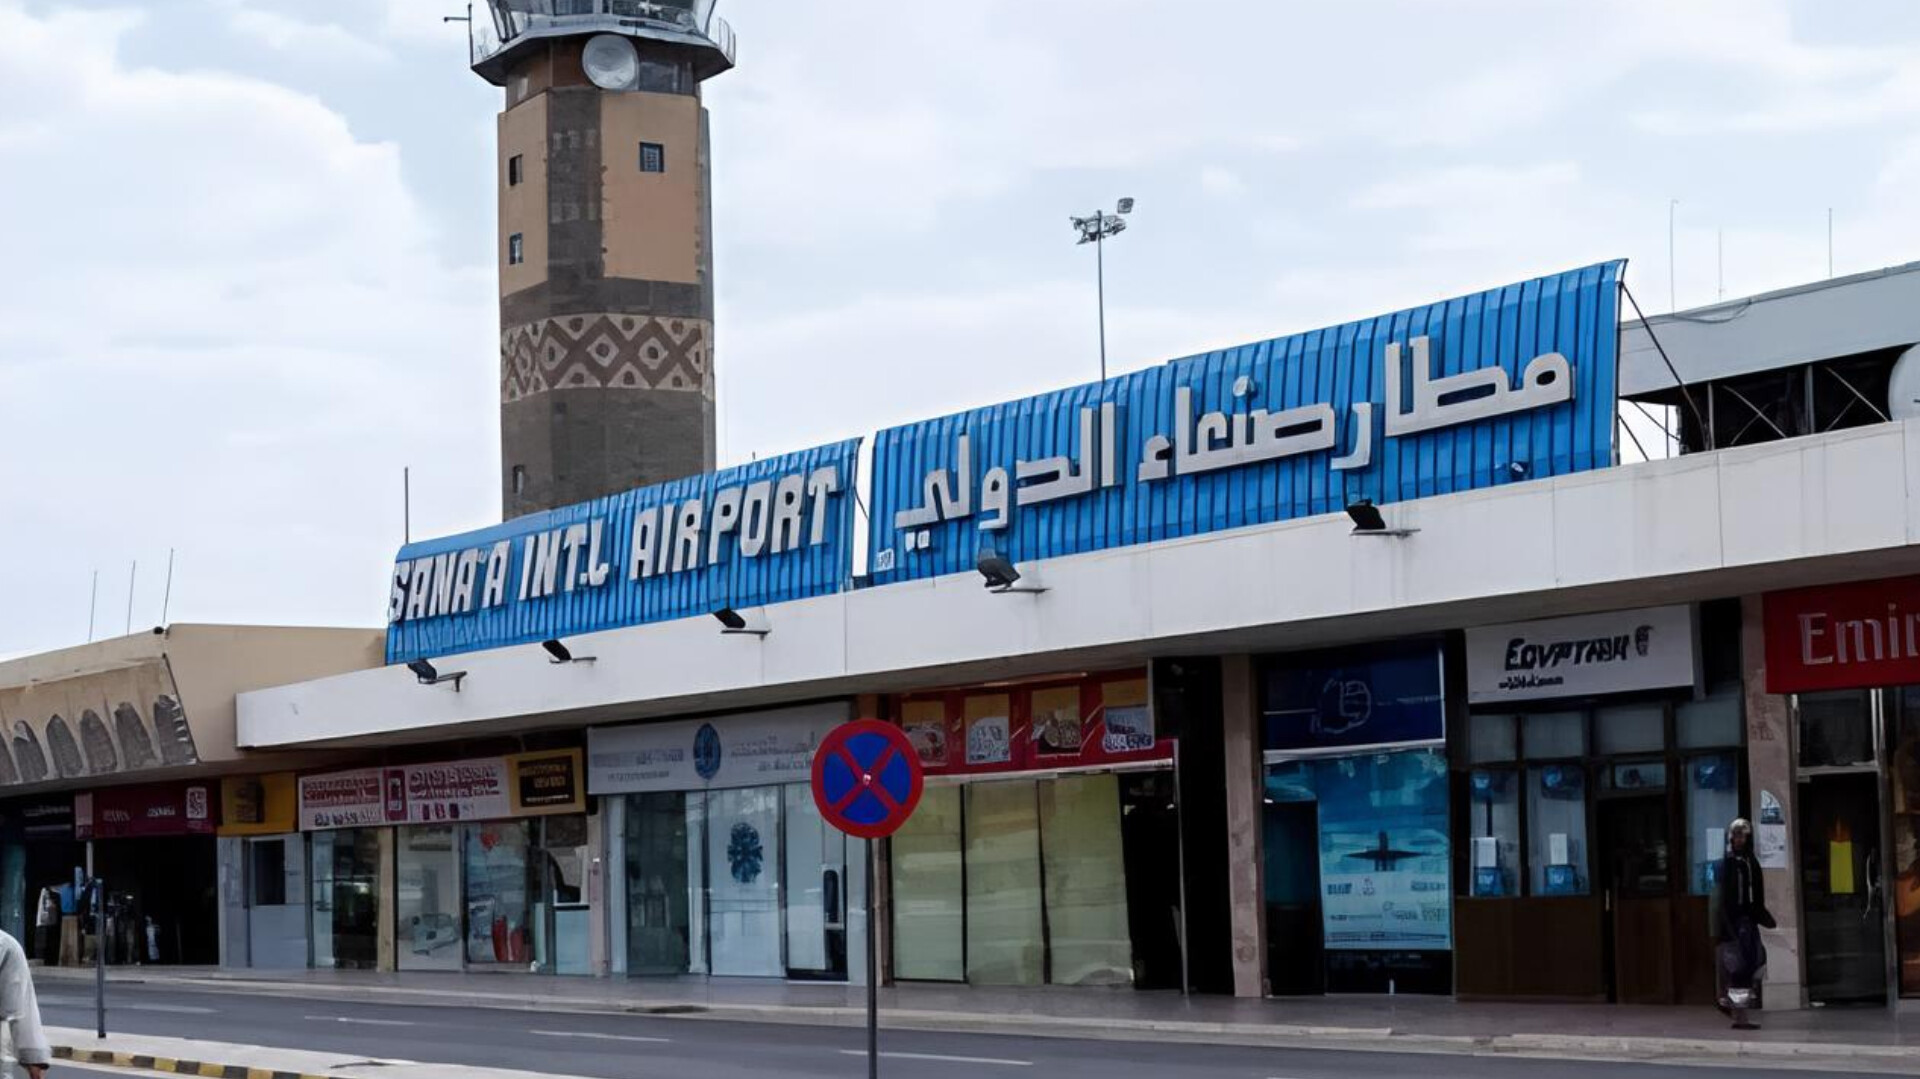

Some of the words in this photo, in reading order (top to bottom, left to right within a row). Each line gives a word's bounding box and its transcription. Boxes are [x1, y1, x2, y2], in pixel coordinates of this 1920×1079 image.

[1138, 376, 1335, 482] صنعاء
[1331, 336, 1571, 469] مطار
[630, 467, 843, 580] AIRPORT
[895, 402, 1117, 552] الدولي
